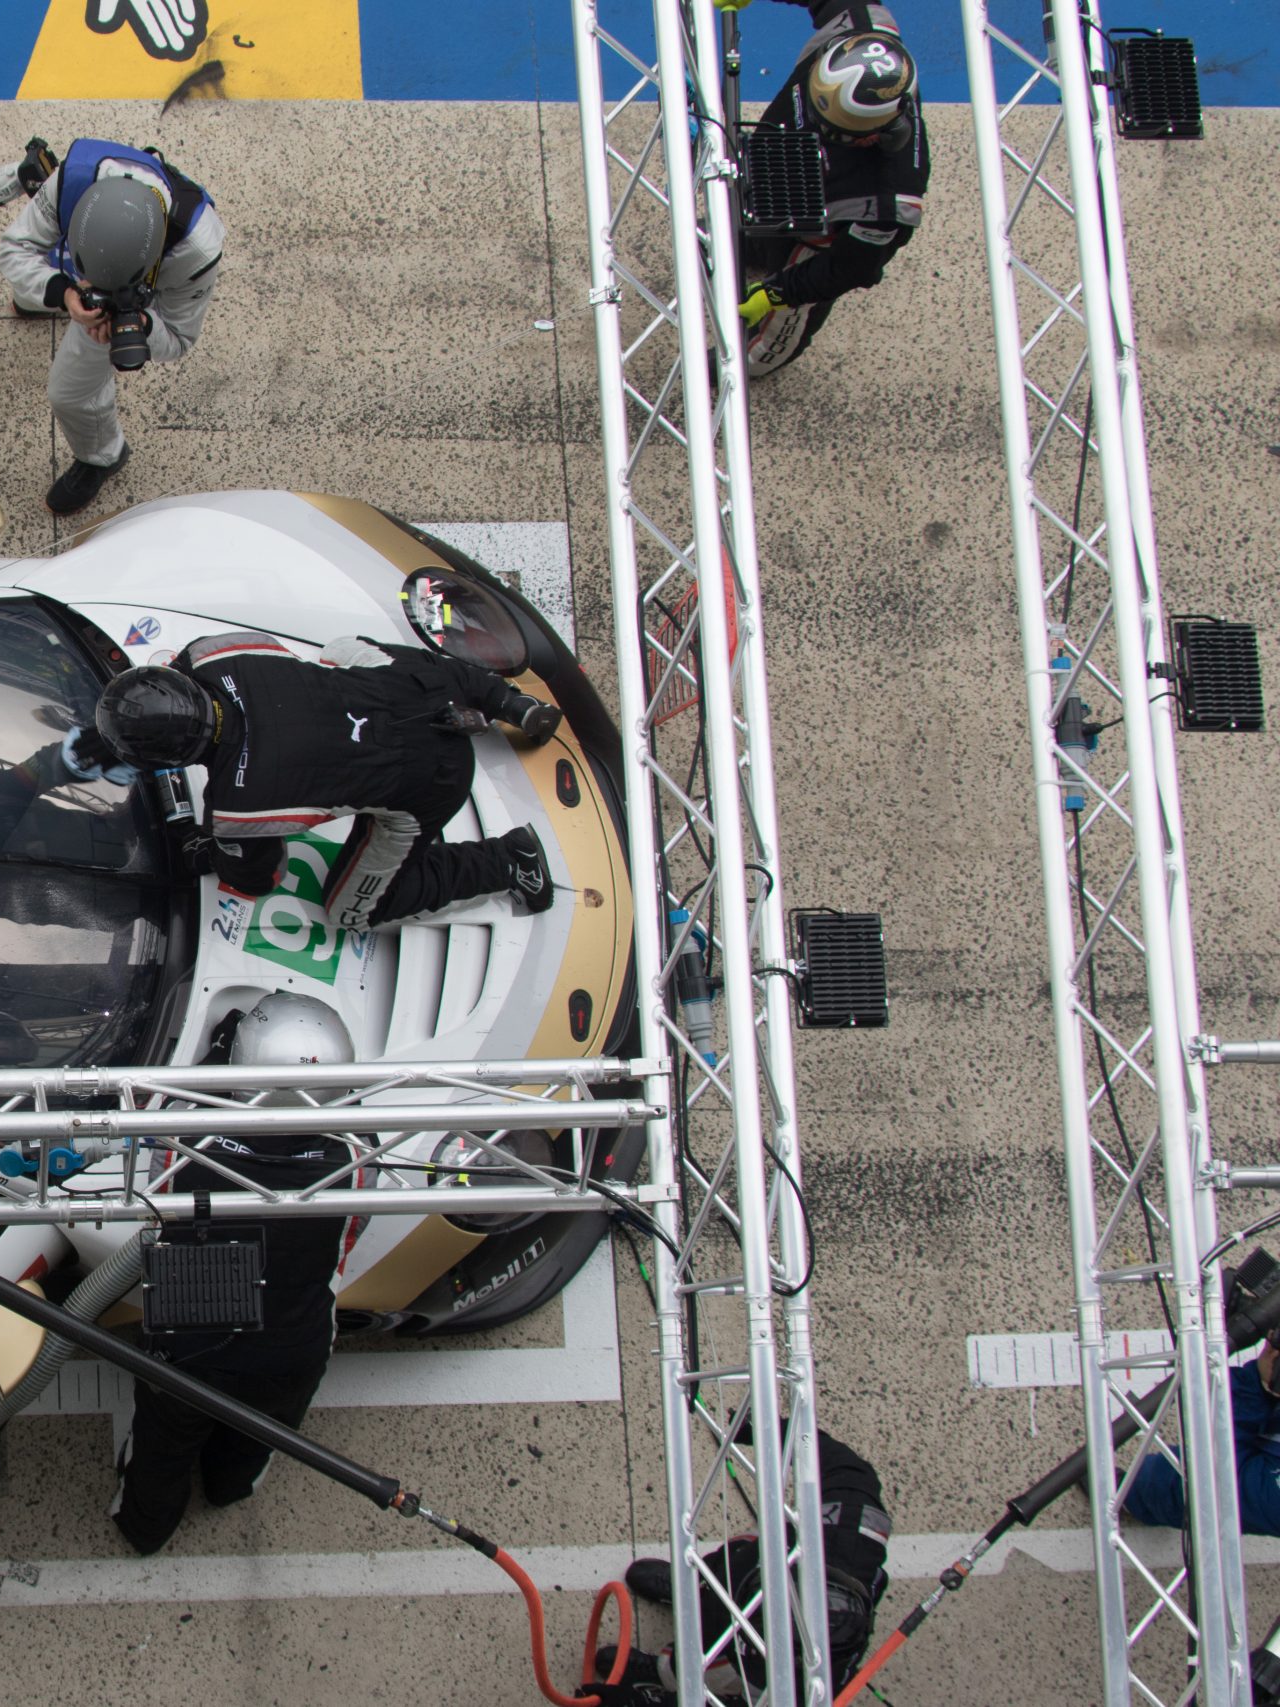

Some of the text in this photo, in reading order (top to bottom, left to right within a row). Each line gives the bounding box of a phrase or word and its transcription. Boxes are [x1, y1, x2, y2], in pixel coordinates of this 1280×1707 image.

[862, 43, 896, 78] 92
[230, 904, 247, 946] LE MANS
[453, 1259, 521, 1312] Mobil
